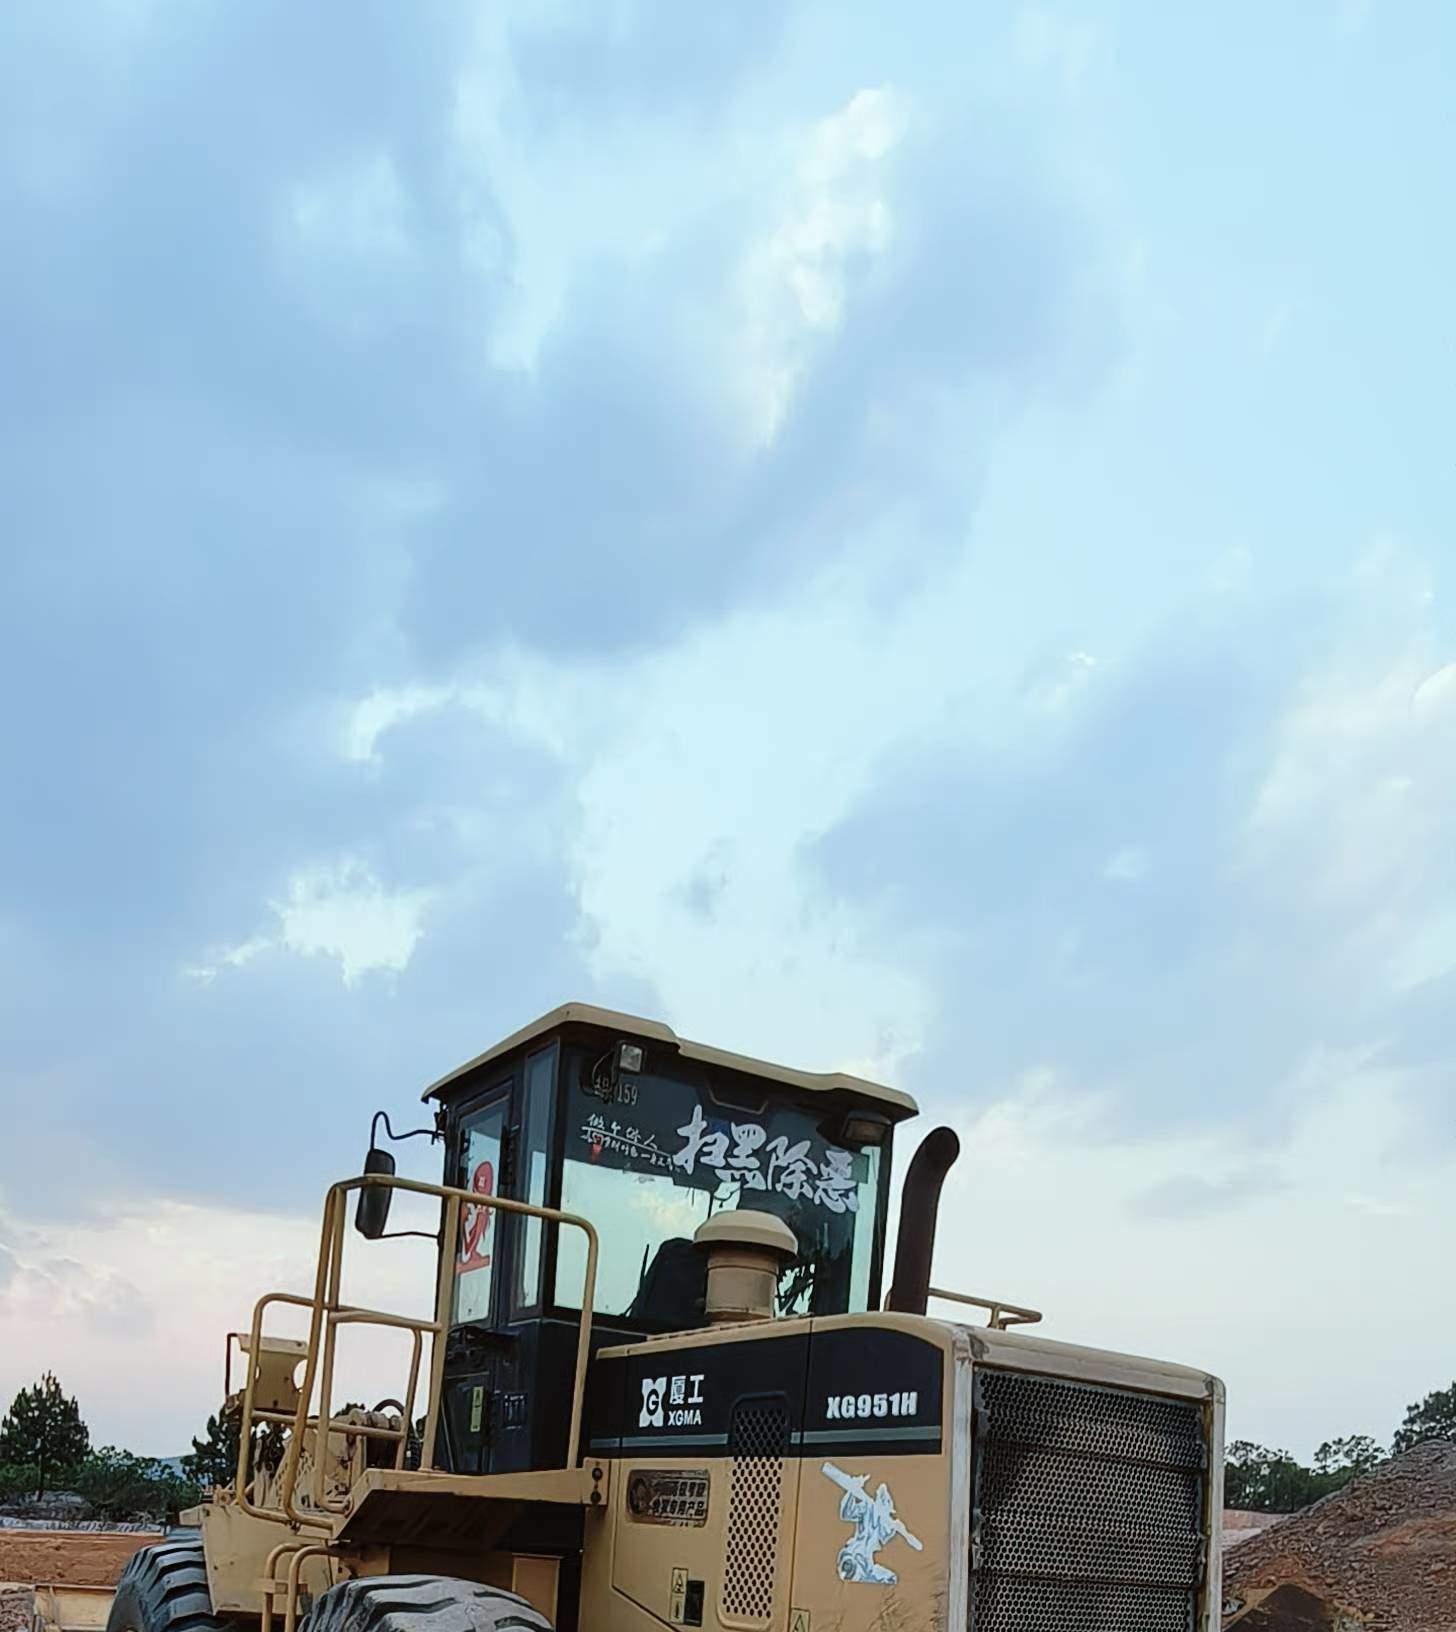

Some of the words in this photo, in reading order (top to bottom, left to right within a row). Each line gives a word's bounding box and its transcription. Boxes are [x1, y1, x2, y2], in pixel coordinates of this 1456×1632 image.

[672, 1104, 860, 1214] 扫黑除恶
[669, 1374, 705, 1404] 厦工
[667, 1409, 702, 1426] XGMA
[826, 1391, 918, 1419] XG951H
